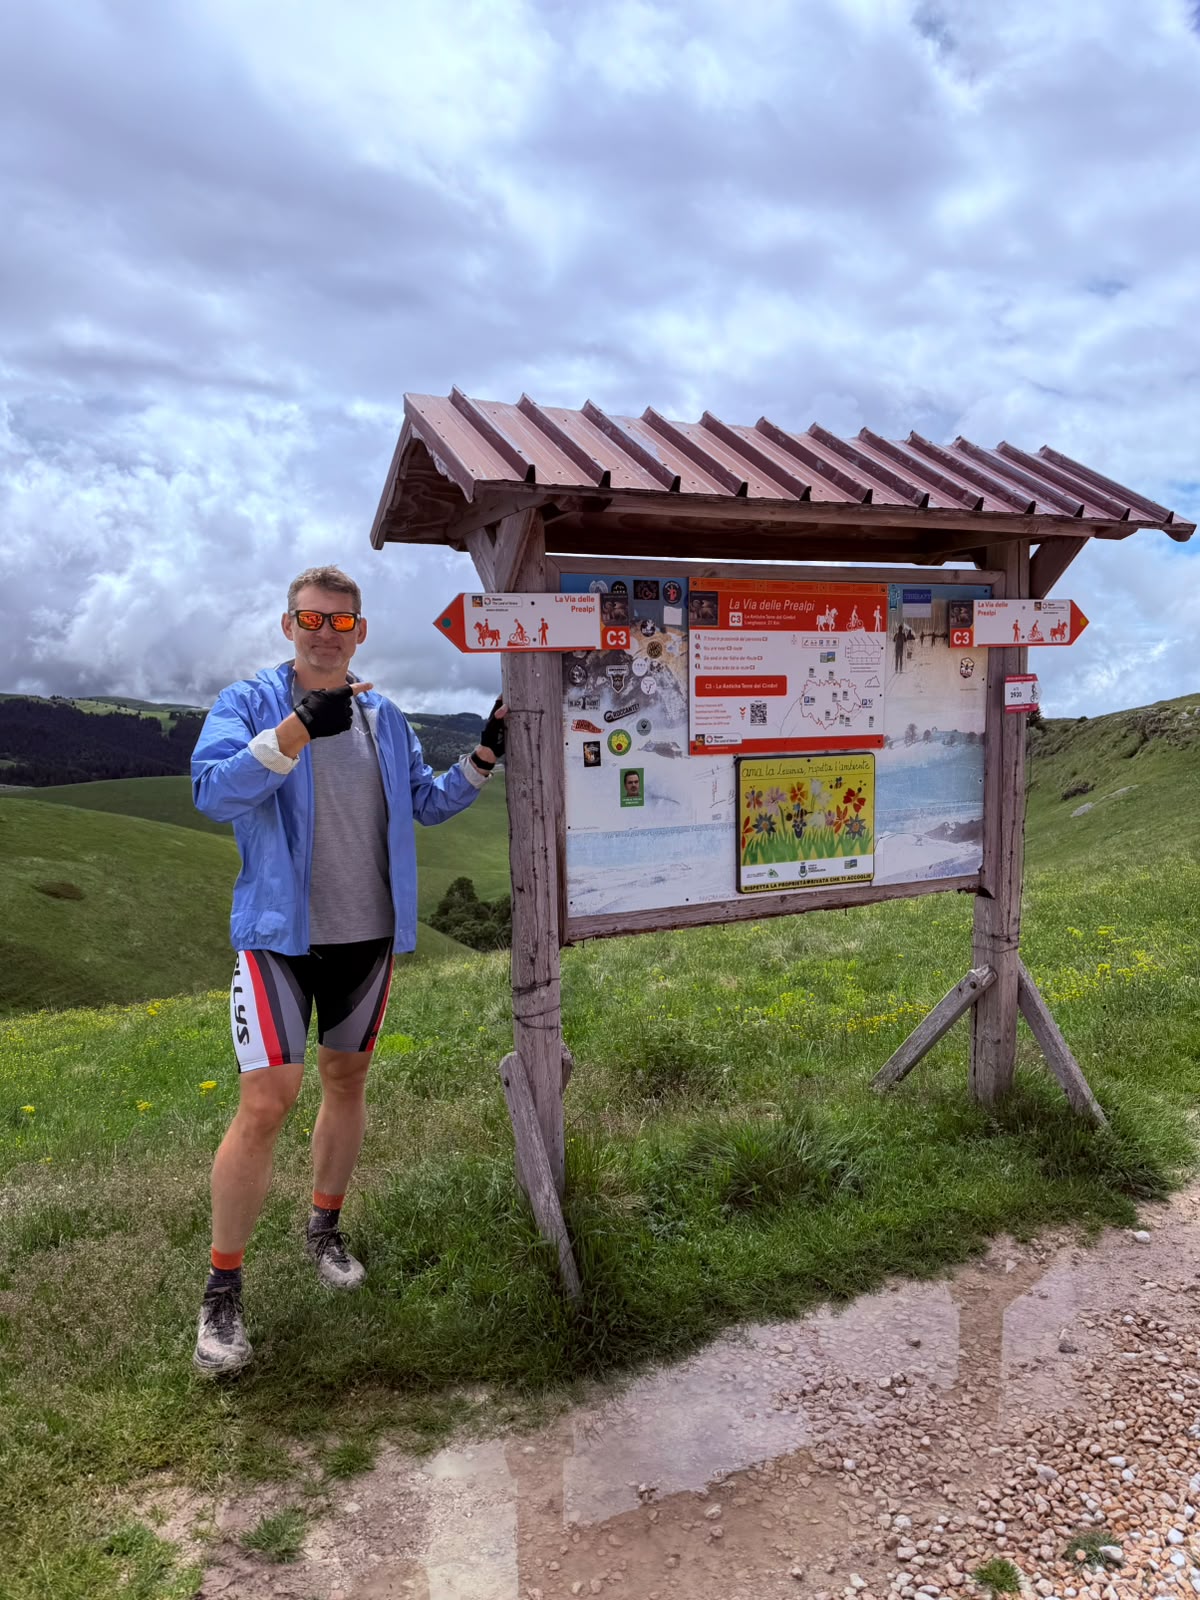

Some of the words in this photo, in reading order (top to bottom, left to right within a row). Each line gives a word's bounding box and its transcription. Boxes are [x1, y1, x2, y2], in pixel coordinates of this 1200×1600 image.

[571, 605, 596, 614] Prealpi
[729, 598, 740, 610] La
[743, 599, 757, 610] Via
[759, 599, 782, 611] delle
[783, 599, 816, 614] Prealpi
[730, 614, 741, 623] C3
[606, 631, 627, 646] C3
[953, 632, 970, 645] C3
[741, 766, 763, 777] ama
[765, 764, 775, 776] la
[744, 883, 769, 891] RISPETTA
